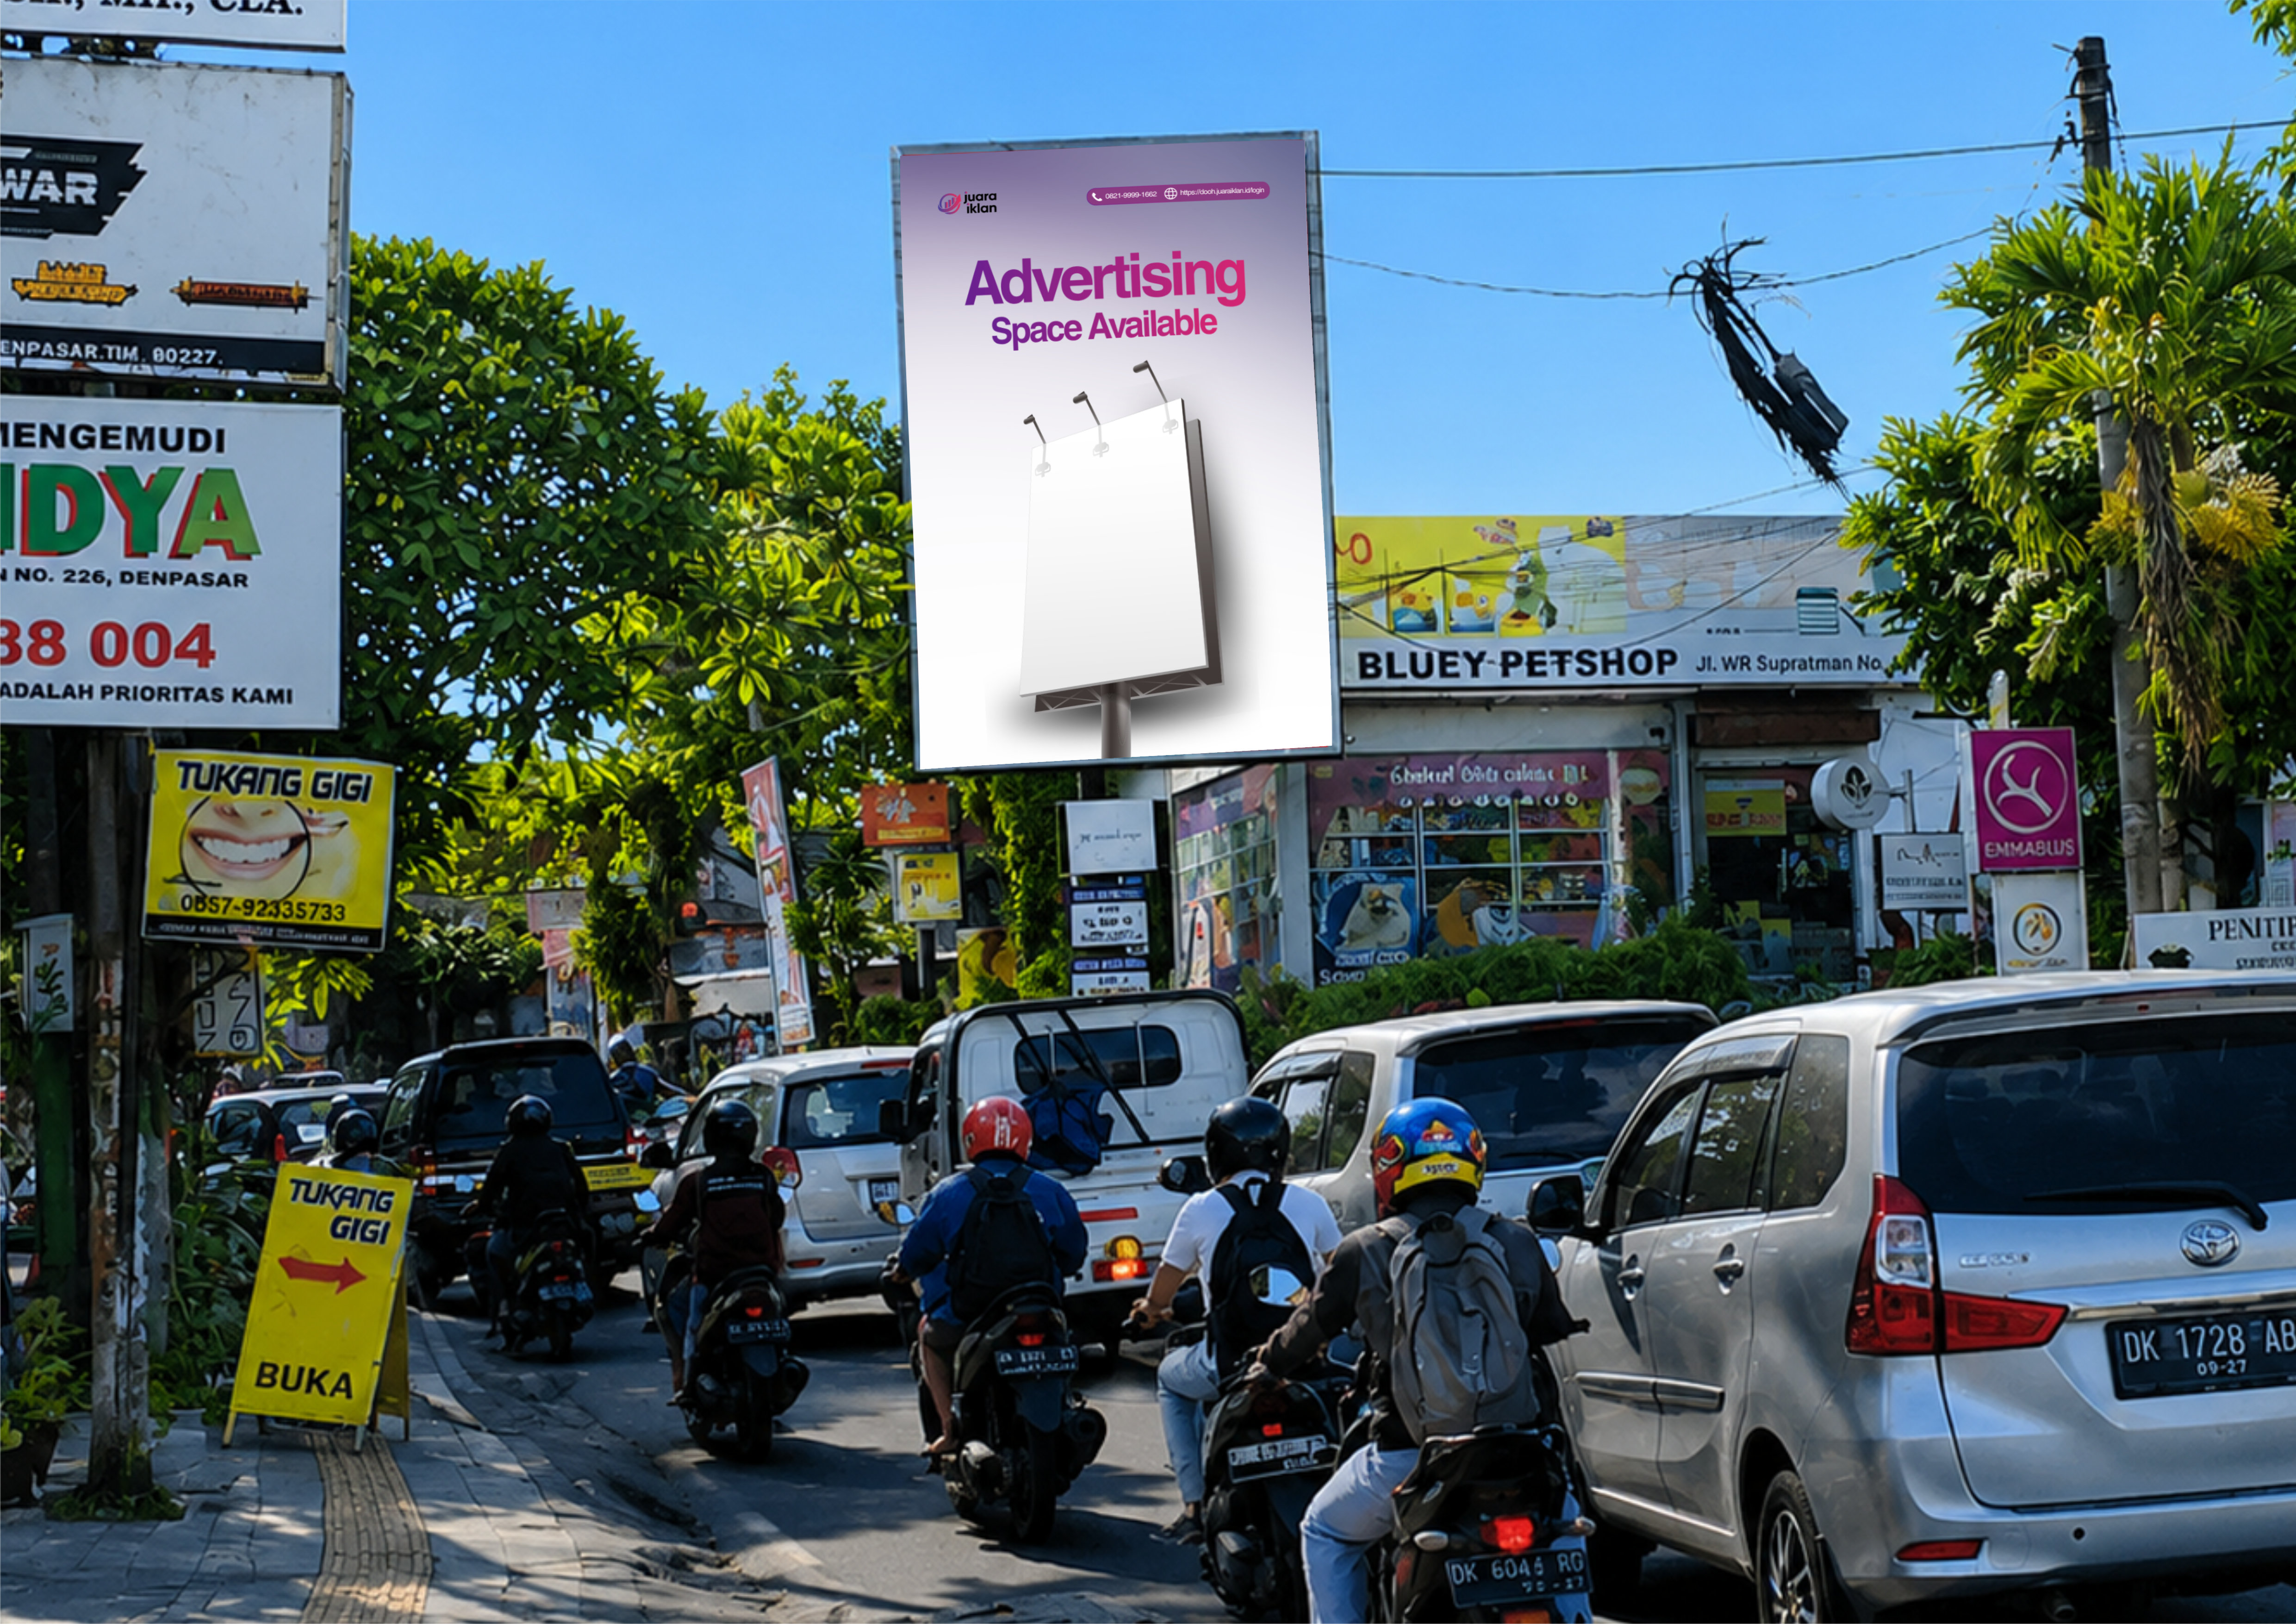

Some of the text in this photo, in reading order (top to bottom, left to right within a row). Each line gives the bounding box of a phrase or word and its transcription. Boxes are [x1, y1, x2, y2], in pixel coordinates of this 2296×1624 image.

[0, 168, 98, 205] WAR
[964, 191, 997, 204] juara
[1180, 187, 1265, 196] https://dooh.juaraiklan.id/login
[966, 203, 997, 214] iklan
[964, 250, 1246, 307] Advertising
[991, 307, 1218, 351] Space Available
[0, 422, 225, 453] ENGEMUDI
[0, 464, 262, 561] DYA
[14, 568, 54, 582] NO.
[63, 569, 112, 587] 226,
[120, 570, 249, 587] DENPASAR
[90, 622, 216, 668] 004
[1696, 656, 1717, 672] Jl.
[1721, 655, 1752, 672] WR
[1757, 655, 1853, 675] Supratman
[0, 682, 293, 705] ADALAH PRIORITAS KAMI
[177, 760, 372, 803] TUKANG GIGI
[290, 1178, 395, 1213] TUKANG
[330, 1215, 392, 1245] GIGI
[2124, 1330, 2160, 1363] DK
[2175, 1324, 2246, 1359] 1728
[255, 1361, 353, 1399] BUKA
[2196, 1359, 2246, 1375] 09-27
[1450, 1562, 1478, 1585] DK
